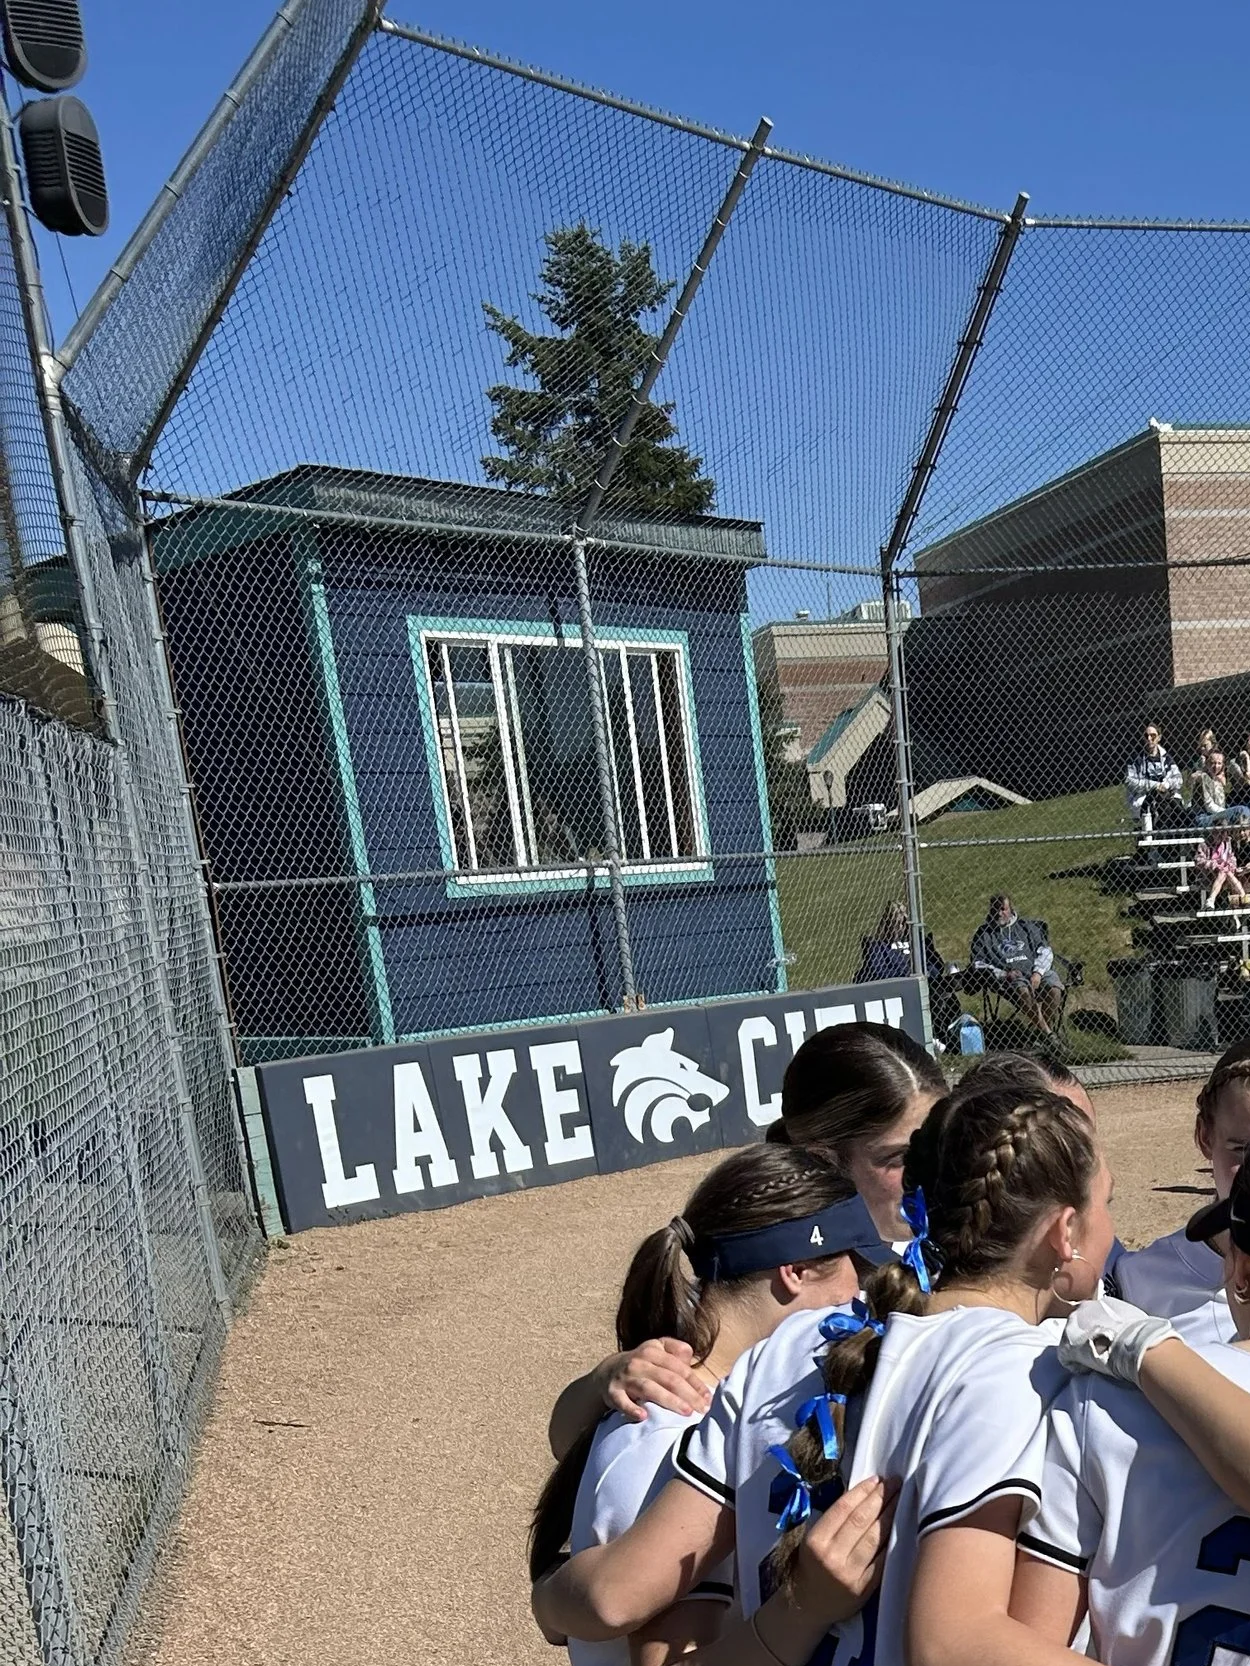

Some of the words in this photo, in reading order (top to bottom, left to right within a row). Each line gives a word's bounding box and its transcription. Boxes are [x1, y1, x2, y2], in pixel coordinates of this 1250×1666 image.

[302, 1040, 595, 1209] LAKE
[737, 997, 904, 1127] CI
[810, 1225, 824, 1246] 4
